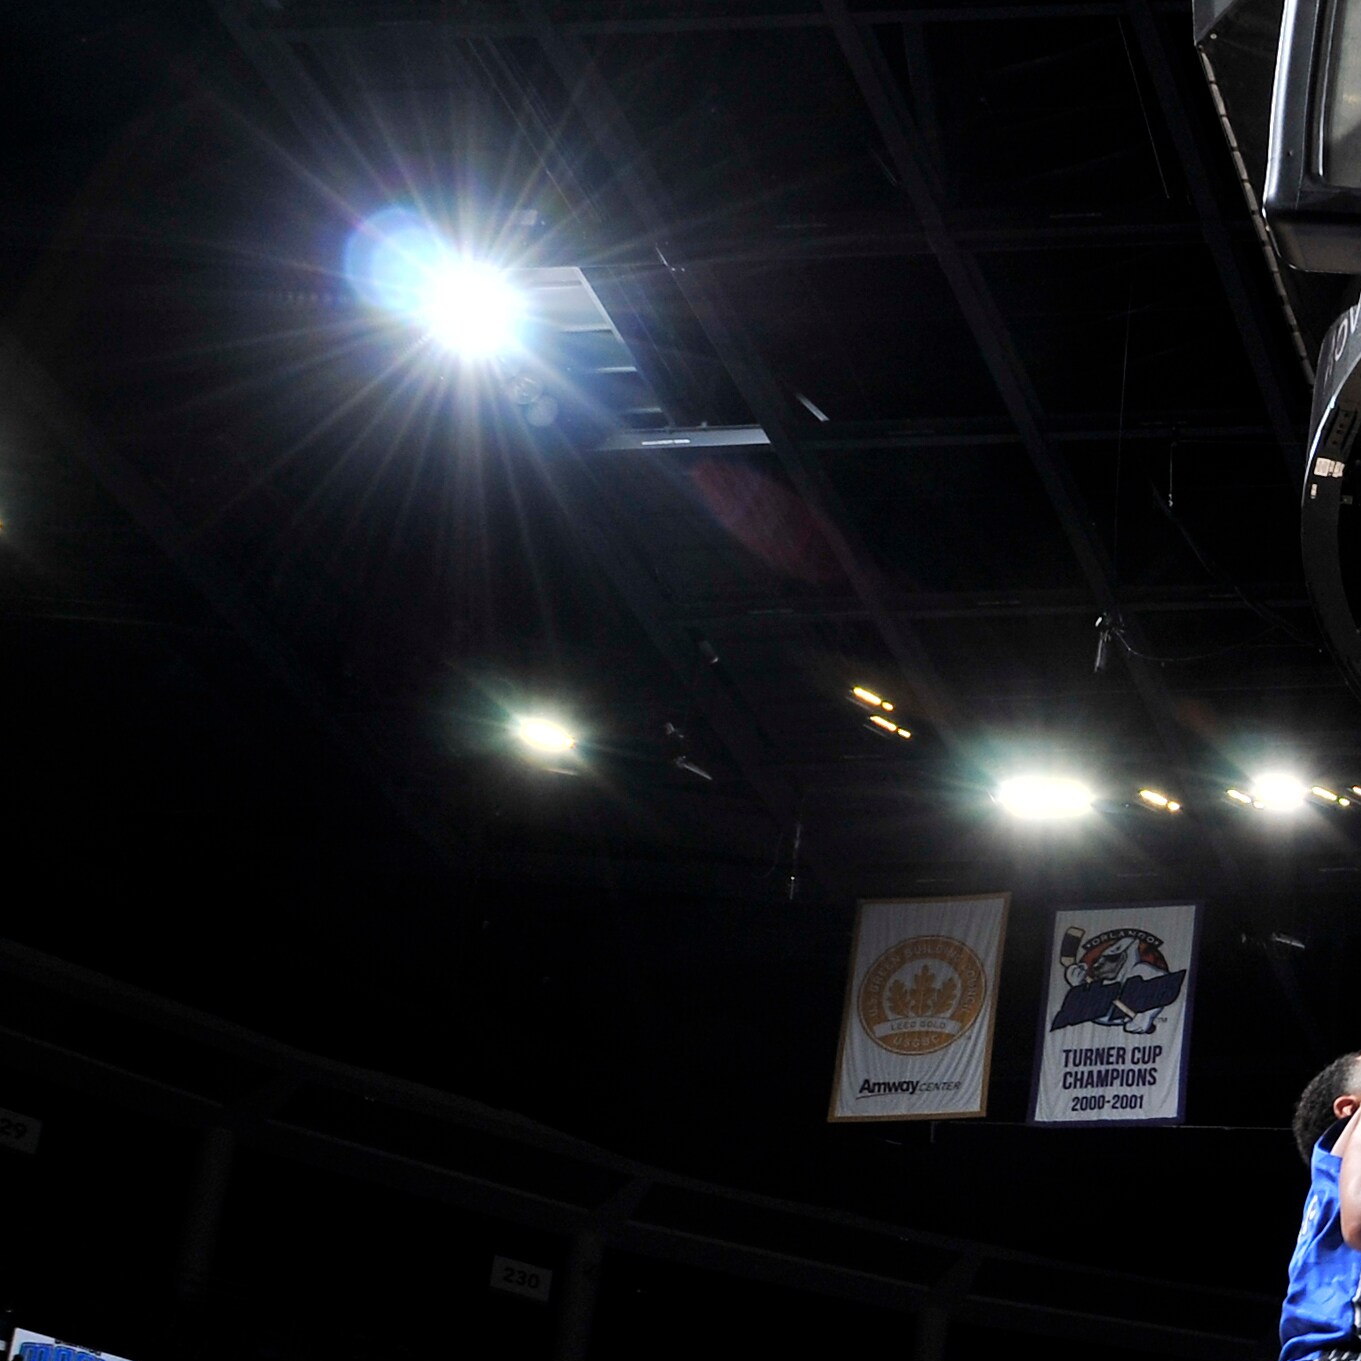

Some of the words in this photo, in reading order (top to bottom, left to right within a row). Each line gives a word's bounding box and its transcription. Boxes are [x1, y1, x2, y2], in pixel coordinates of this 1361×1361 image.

[1063, 1046, 1126, 1067] TURNER
[1131, 1045, 1162, 1065] CUP
[859, 1079, 919, 1095] Amway
[1063, 1068, 1157, 1090] CHAMPIONS
[1071, 1094, 1144, 1111] 2000-2001
[504, 1267, 538, 1289] 230
